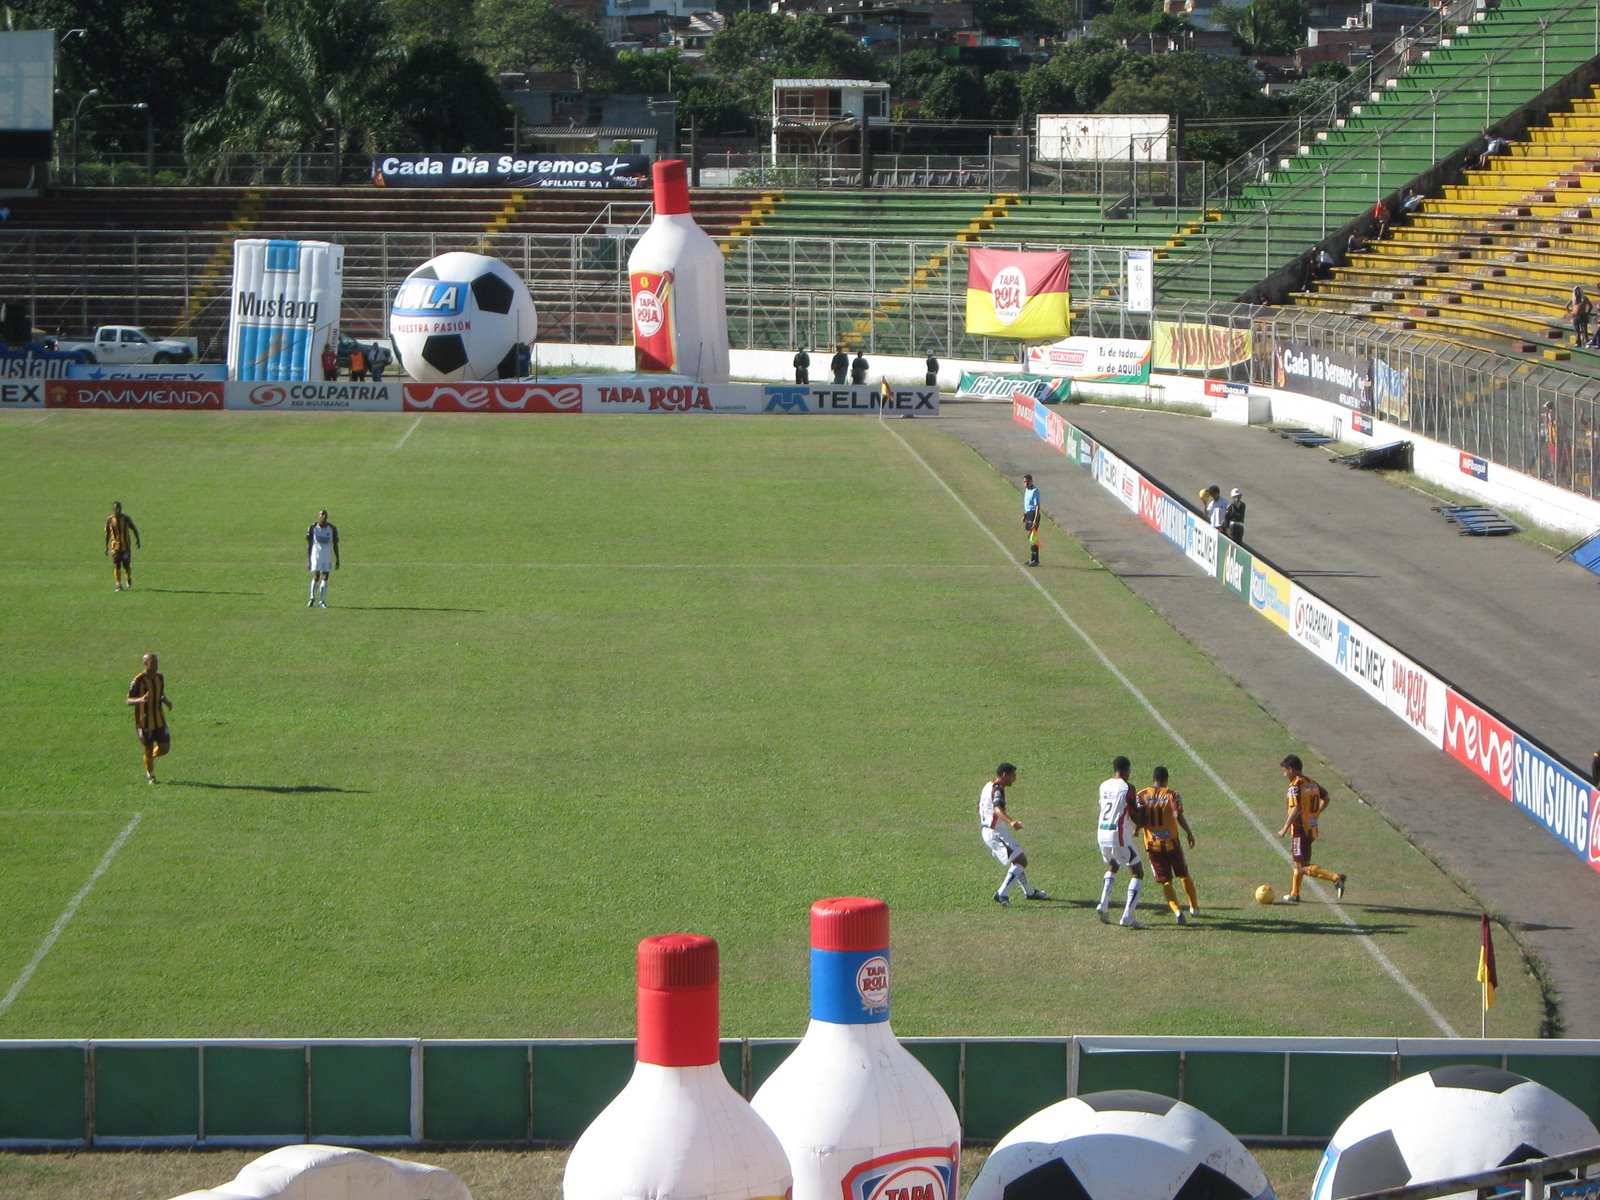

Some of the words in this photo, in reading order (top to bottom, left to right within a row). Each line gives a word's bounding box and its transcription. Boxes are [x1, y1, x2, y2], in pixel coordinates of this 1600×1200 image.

[381, 157, 443, 175] Cada
[451, 156, 489, 174] Día
[496, 155, 603, 174] Seremos
[540, 179, 586, 187] AFILIATE
[588, 180, 603, 188] YA
[1000, 274, 1020, 286] TAPA
[238, 291, 318, 324] Mustang
[639, 298, 656, 308] TAPA
[994, 286, 1021, 310] ROJA
[637, 308, 660, 322] ROJA
[434, 321, 471, 333] PASIÓN
[1042, 351, 1083, 364] ercacentro
[1108, 347, 1116, 358] de
[1106, 364, 1115, 373] de
[1284, 349, 1309, 377] Cada
[1311, 353, 1324, 380] Día
[1325, 356, 1352, 389] Seremos
[77, 389, 220, 404] DAVIVIENDA
[290, 385, 389, 400] COLPATRIA
[968, 376, 1048, 398] Gatorade
[404, 387, 489, 409] une
[495, 387, 581, 409] une
[598, 387, 645, 403] TAPA
[648, 385, 713, 411] ROJA
[813, 391, 935, 410] TELMEX
[1161, 499, 1187, 549] SAMSUNG
[1194, 527, 1217, 567] TELMEX
[1305, 603, 1333, 642] COLPATRIA
[1350, 634, 1386, 692] TELMEX
[1392, 659, 1406, 699] TAPA
[1405, 670, 1428, 732] ROJA
[1515, 742, 1589, 852] SAMSUNG
[1103, 802, 1113, 821] 2
[866, 966, 886, 976] TAPA
[863, 976, 887, 991] ROJA
